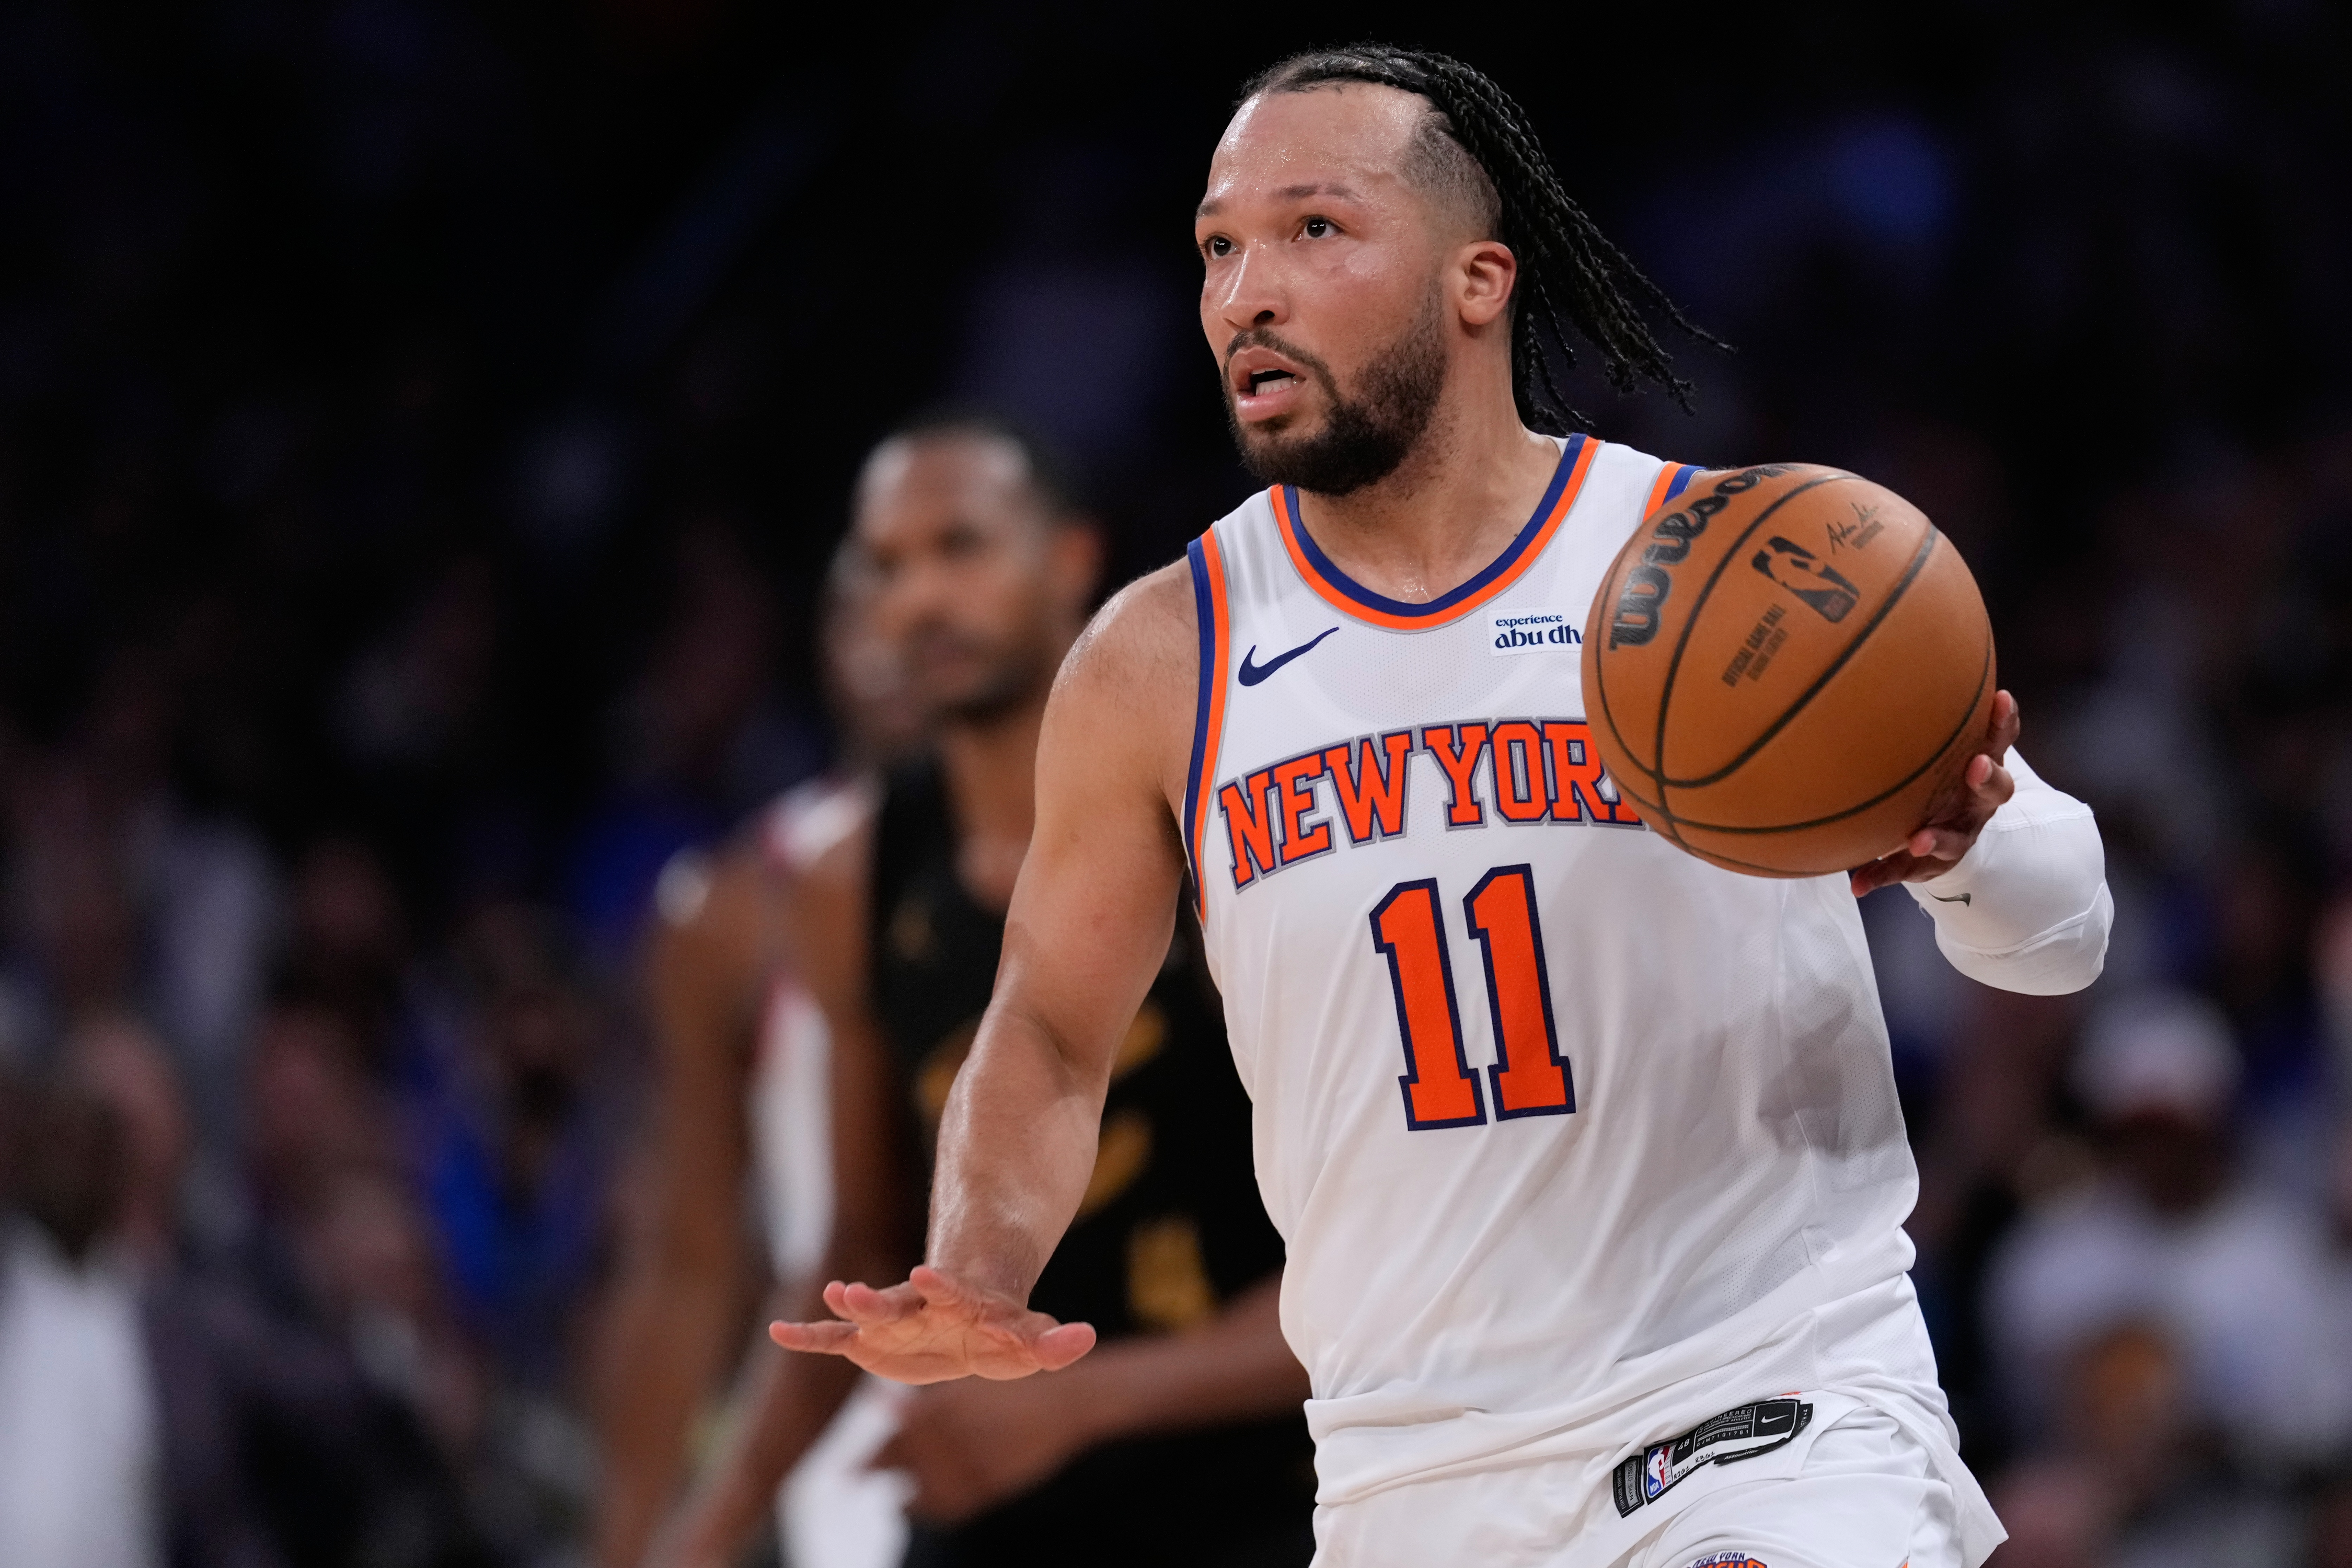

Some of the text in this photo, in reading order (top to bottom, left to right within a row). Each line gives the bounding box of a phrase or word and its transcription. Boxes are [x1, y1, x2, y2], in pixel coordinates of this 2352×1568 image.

[1496, 615, 1563, 628] experience
[1495, 625, 1584, 649] abu dh
[1216, 717, 1656, 894] NEW YOR
[1369, 863, 1576, 1131] 11
[1678, 1438, 1690, 1451] 48
[1650, 1481, 1659, 1494] NBA
